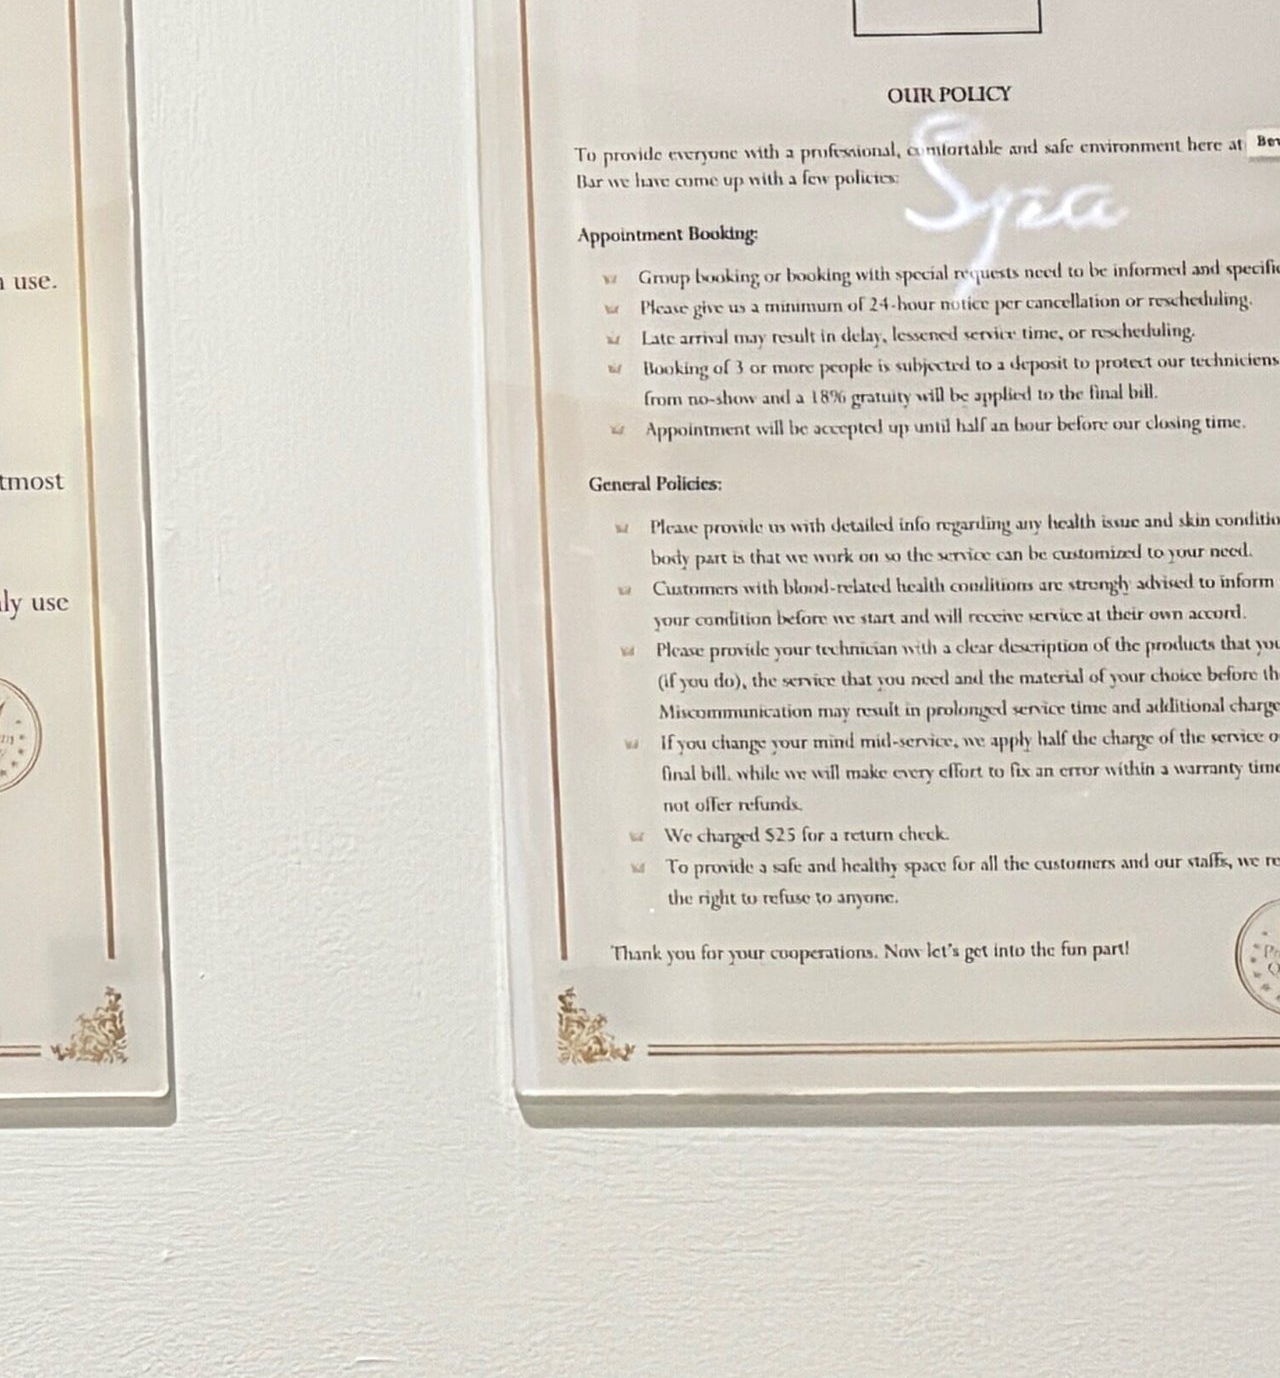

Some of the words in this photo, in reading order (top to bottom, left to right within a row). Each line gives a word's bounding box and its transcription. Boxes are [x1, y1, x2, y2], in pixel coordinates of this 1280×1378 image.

[887, 86, 937, 105] OUR
[938, 84, 1013, 104] POLICY
[576, 225, 684, 250] Appointment
[687, 223, 759, 248] Booking:
[13, 274, 58, 291] use.
[588, 473, 652, 493] General
[656, 473, 723, 493] Policies:
[663, 826, 693, 844] We
[696, 824, 761, 850] charged
[764, 825, 796, 844] $25
[801, 824, 826, 844] for
[829, 830, 839, 843] a
[843, 829, 894, 843] return
[898, 823, 950, 843] check.
